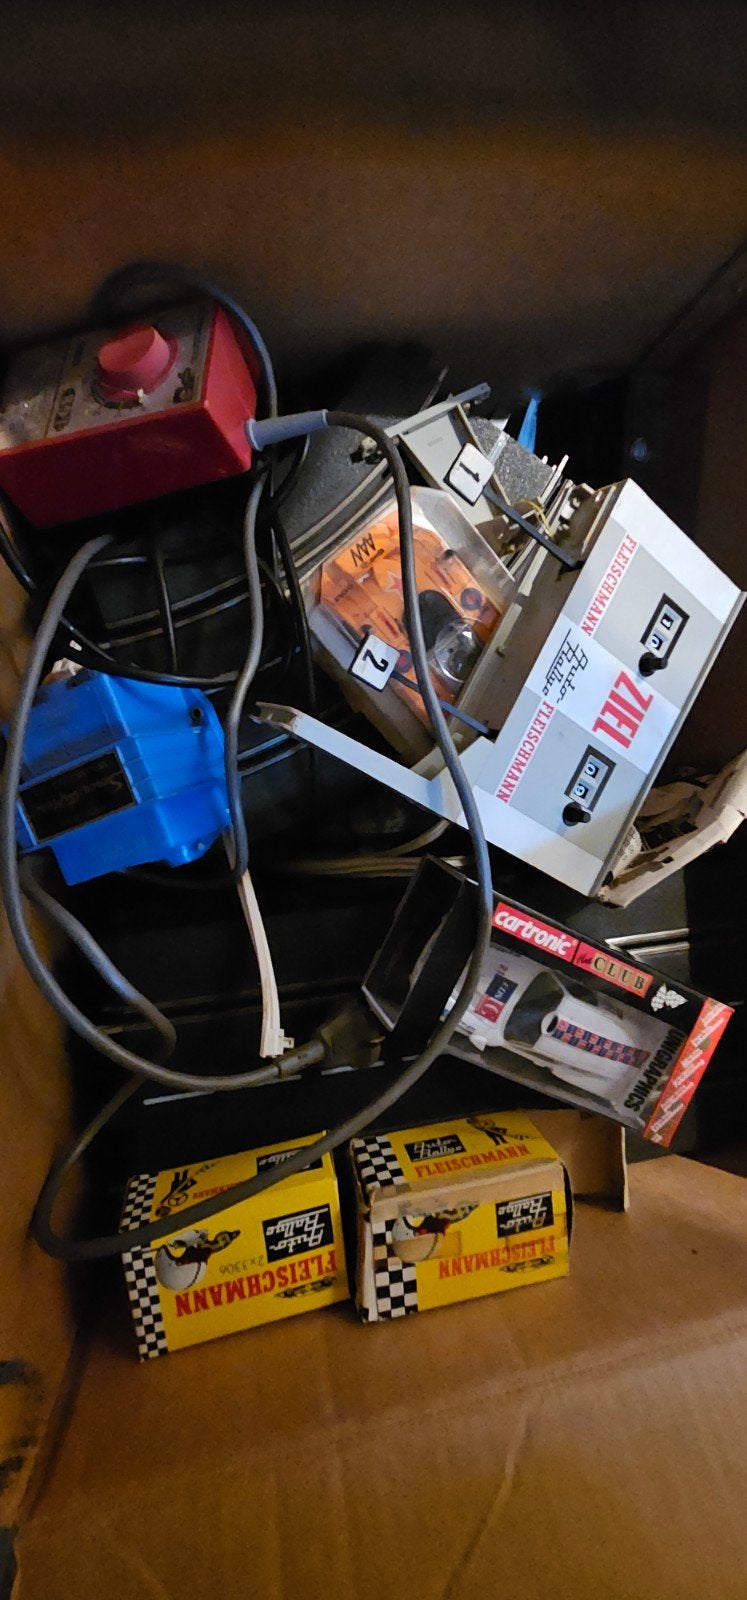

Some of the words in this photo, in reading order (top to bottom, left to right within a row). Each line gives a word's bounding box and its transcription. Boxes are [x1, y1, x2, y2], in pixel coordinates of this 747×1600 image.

[459, 461, 480, 483] 1
[580, 533, 638, 637] FLEISCHMANN
[362, 648, 390, 673] 2
[542, 629, 580, 697] Rallye
[591, 670, 655, 750] ZIEL
[495, 700, 555, 804] FLEISCHMANN
[494, 910, 573, 956] cartronic
[593, 956, 645, 991] CLUB
[623, 1027, 686, 1113] UNIGRAPHICS
[414, 1144, 531, 1178] FLEISCHMANN
[265, 1207, 330, 1237] Rallye
[497, 1192, 552, 1219] Rallye
[174, 1250, 338, 1318] FLEISCHMANN
[438, 1235, 556, 1280] FLEISCHMANN
